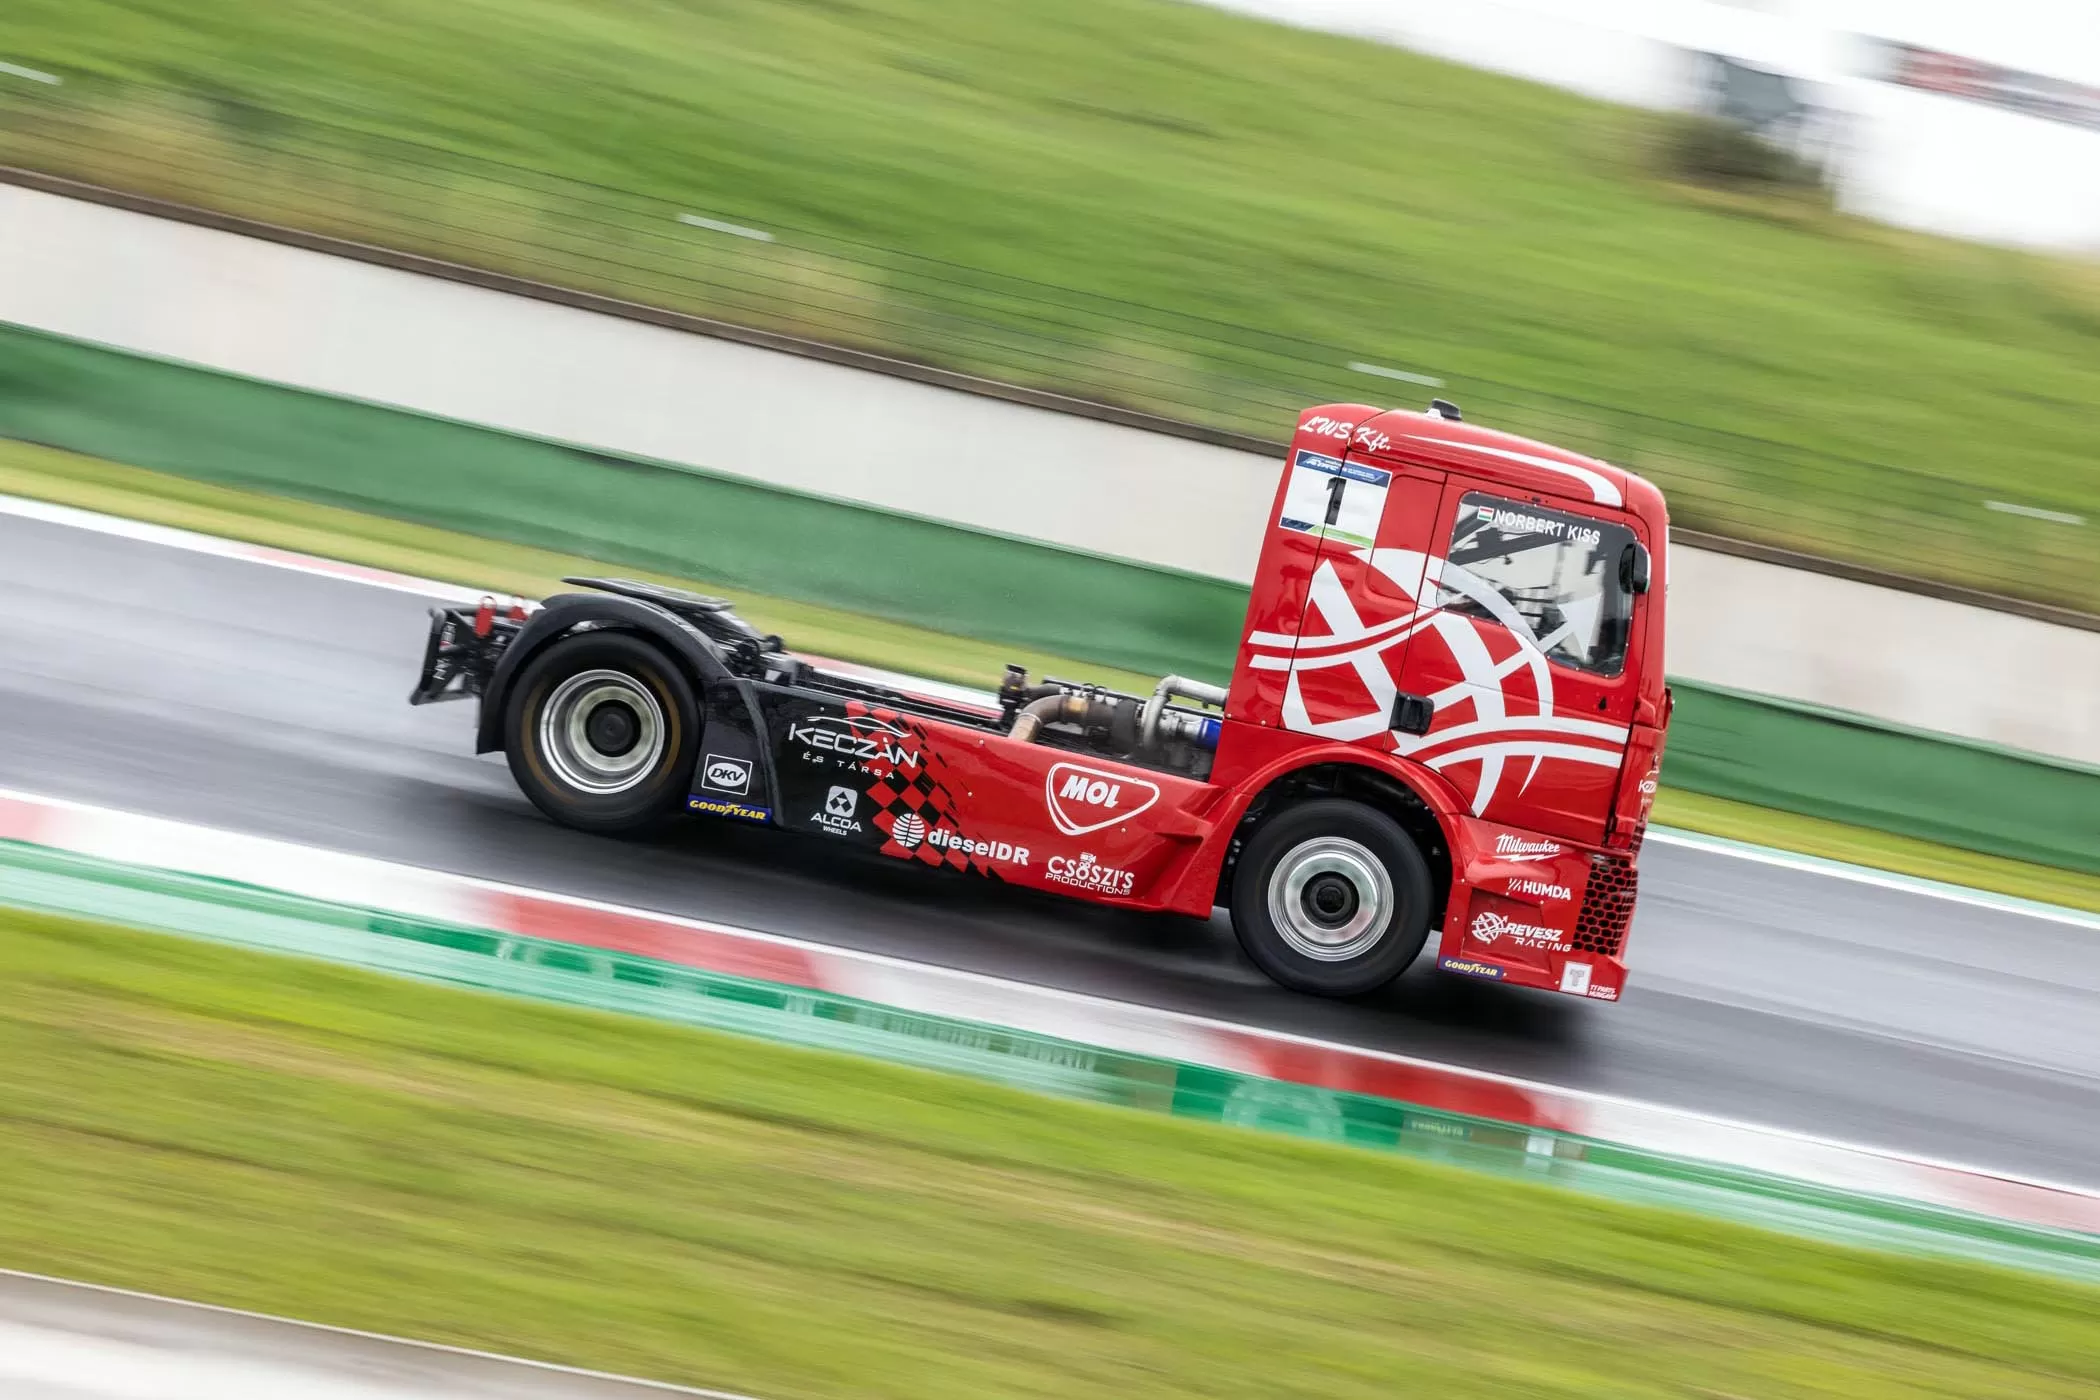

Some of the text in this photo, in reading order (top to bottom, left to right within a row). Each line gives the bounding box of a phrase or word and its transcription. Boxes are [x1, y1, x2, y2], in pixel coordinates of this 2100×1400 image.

[1326, 476, 1347, 526] 1
[1494, 509, 1601, 545] NORBERT KISS
[710, 768, 744, 781] DKV
[837, 760, 894, 779] TÁRSA
[1059, 774, 1120, 808] MOL
[689, 800, 766, 820] GOODYEAR
[810, 812, 862, 832] ALCOA
[822, 825, 848, 836] WHEELS
[928, 827, 1030, 866] dieselDR
[1495, 831, 1561, 854] Milwaukee
[1044, 872, 1131, 896] PRODUCTIONS
[1522, 880, 1572, 901] HUMDA
[1514, 937, 1572, 953] RACING
[1444, 959, 1499, 977] GOODYEAR
